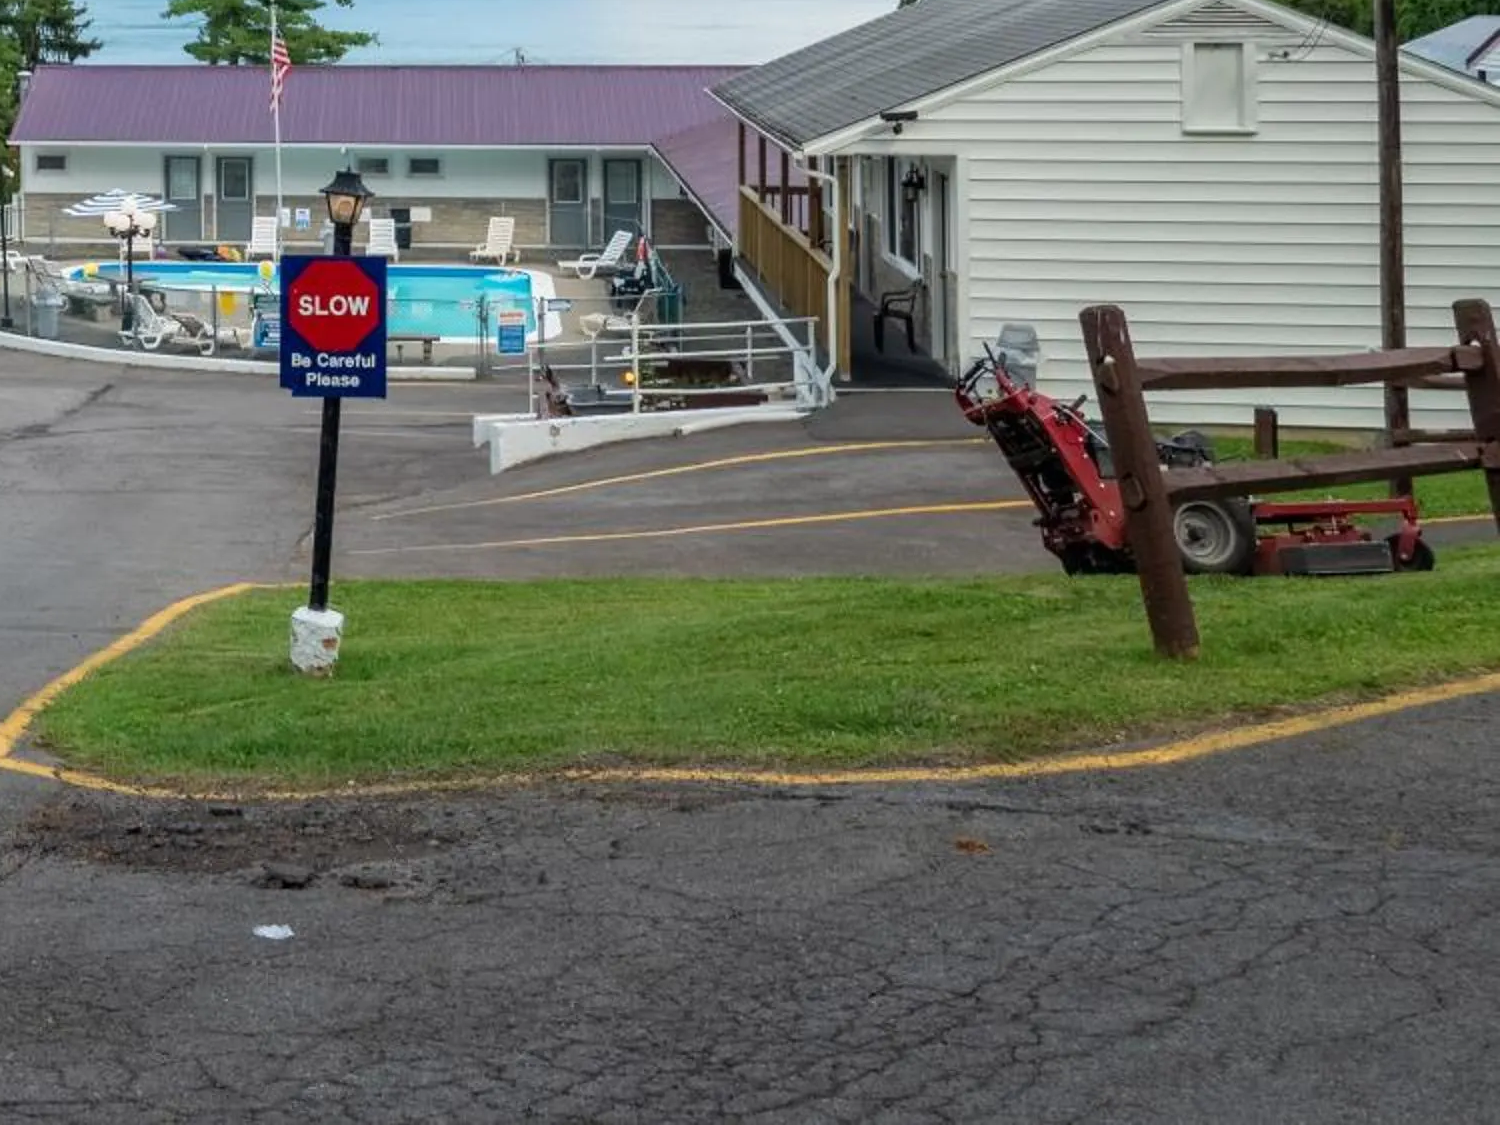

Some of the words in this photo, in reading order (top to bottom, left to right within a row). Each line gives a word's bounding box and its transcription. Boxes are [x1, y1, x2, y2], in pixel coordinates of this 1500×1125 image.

[298, 295, 370, 316] SLOW
[291, 353, 312, 368] Be
[317, 352, 376, 368] Careful
[306, 372, 361, 387] Please
